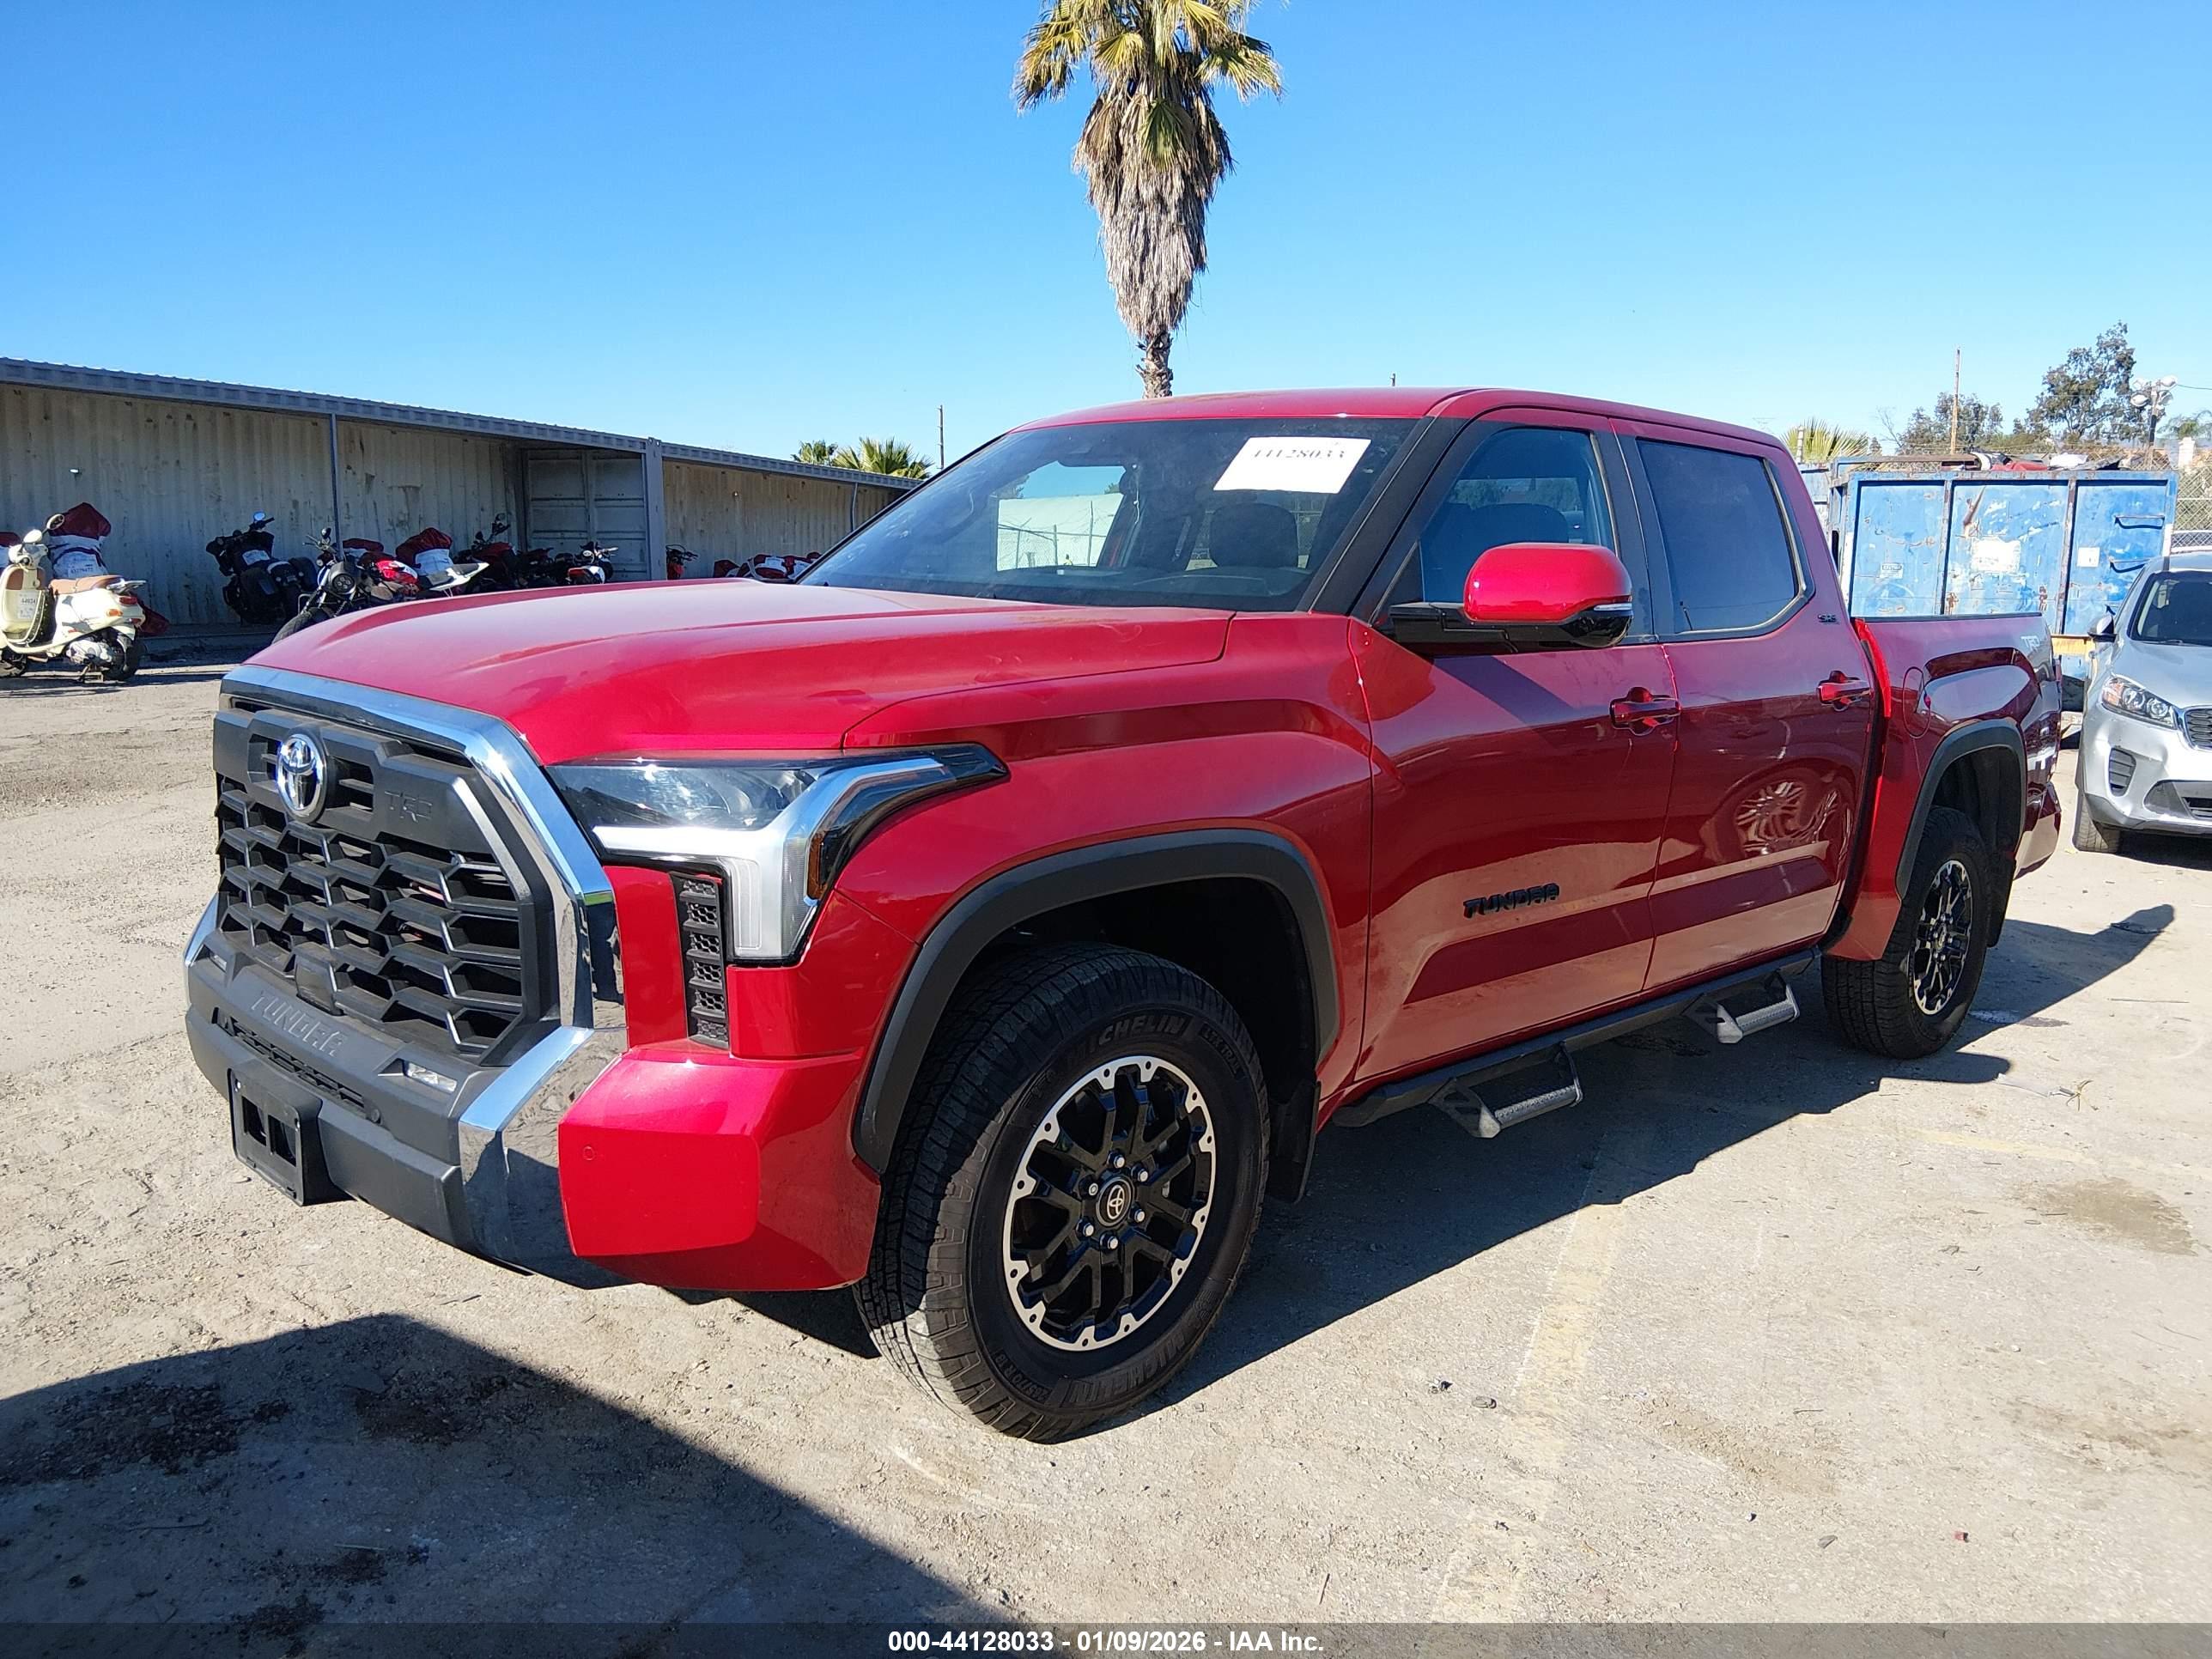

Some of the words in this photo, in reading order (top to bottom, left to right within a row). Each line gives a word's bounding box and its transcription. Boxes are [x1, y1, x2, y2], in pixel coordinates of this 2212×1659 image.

[385, 790, 433, 824] TRD
[1462, 882, 1560, 919] TUNDRA
[250, 991, 345, 1057] TUNDRA
